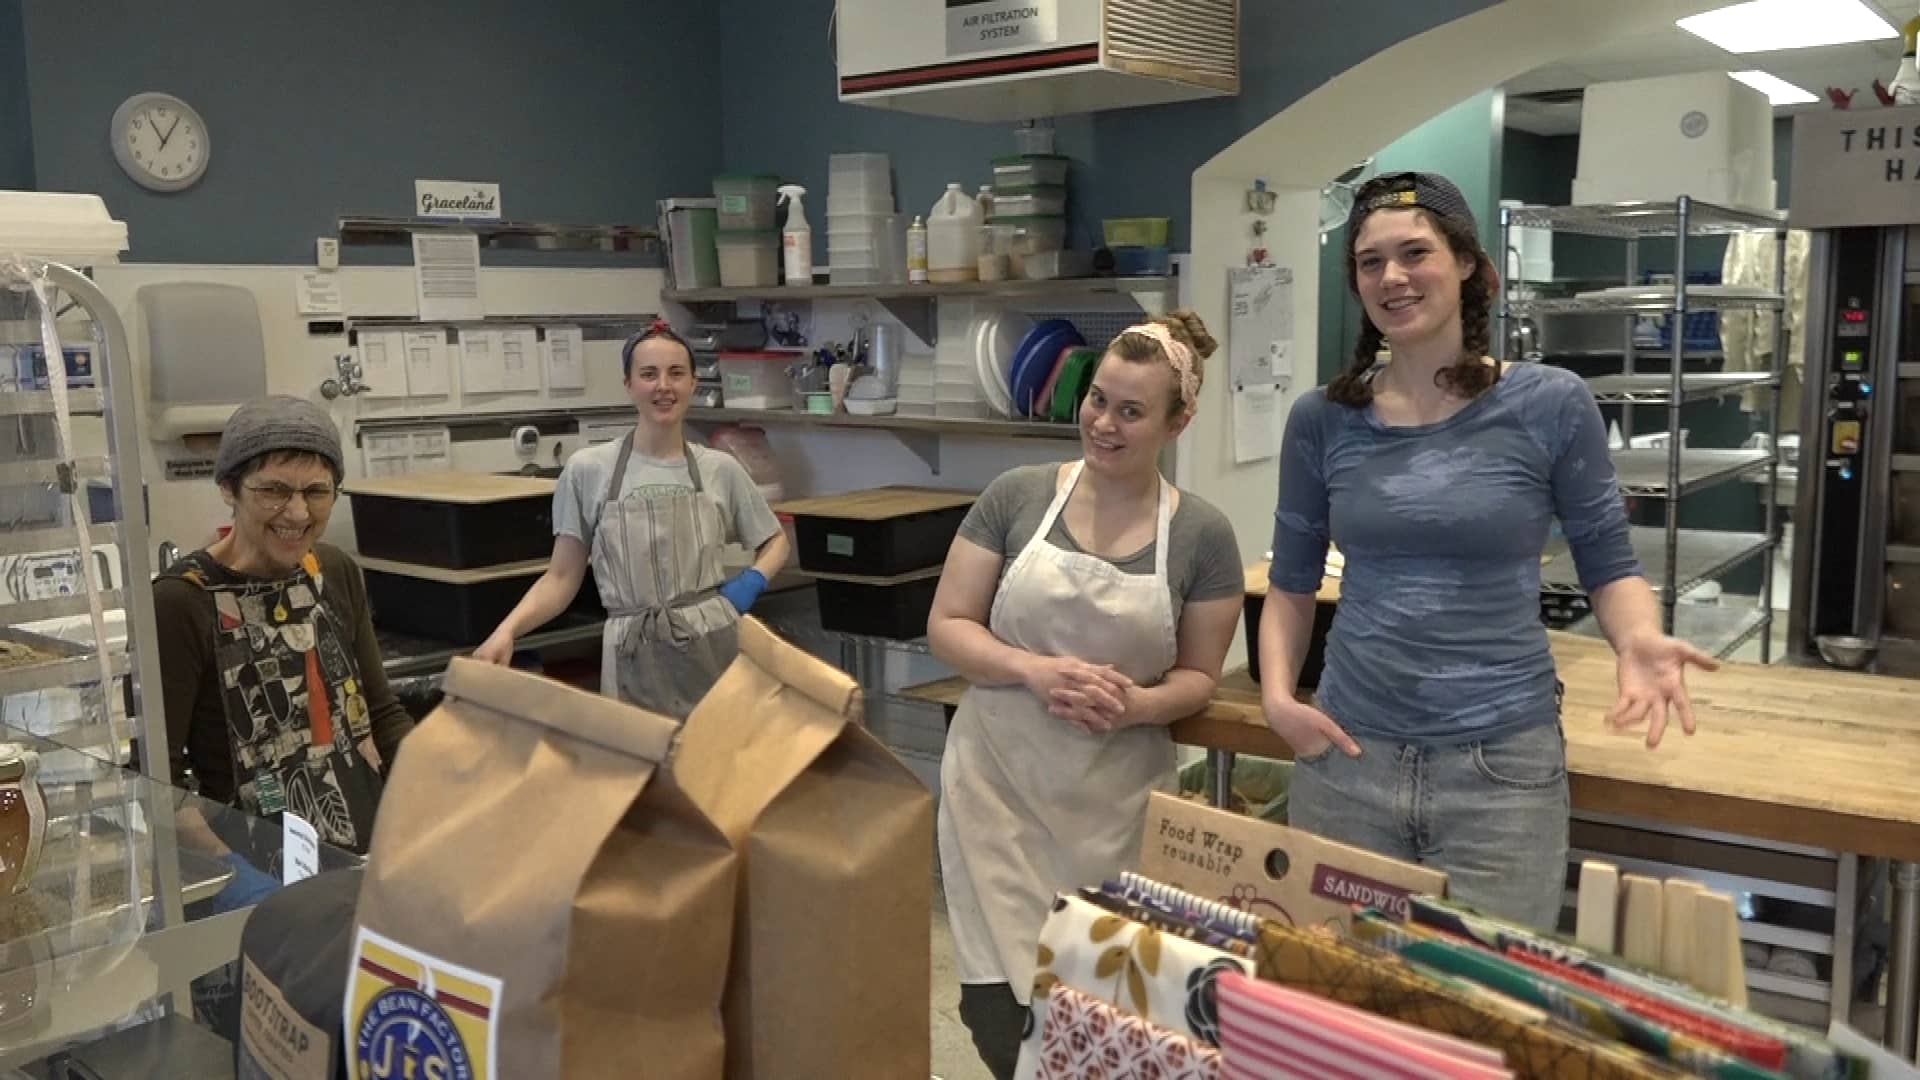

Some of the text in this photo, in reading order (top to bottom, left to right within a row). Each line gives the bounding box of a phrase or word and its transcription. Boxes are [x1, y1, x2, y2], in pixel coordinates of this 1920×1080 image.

[963, 7, 1038, 27] AIR FILTRATION
[980, 25, 1019, 40] SYSTEM
[131, 119, 142, 130] 10
[421, 193, 496, 213] Graceland
[1159, 817, 1243, 863] Food Wrap
[1162, 844, 1231, 877] reusable
[359, 1009, 379, 1048] THE
[378, 995, 420, 1015] BEAN
